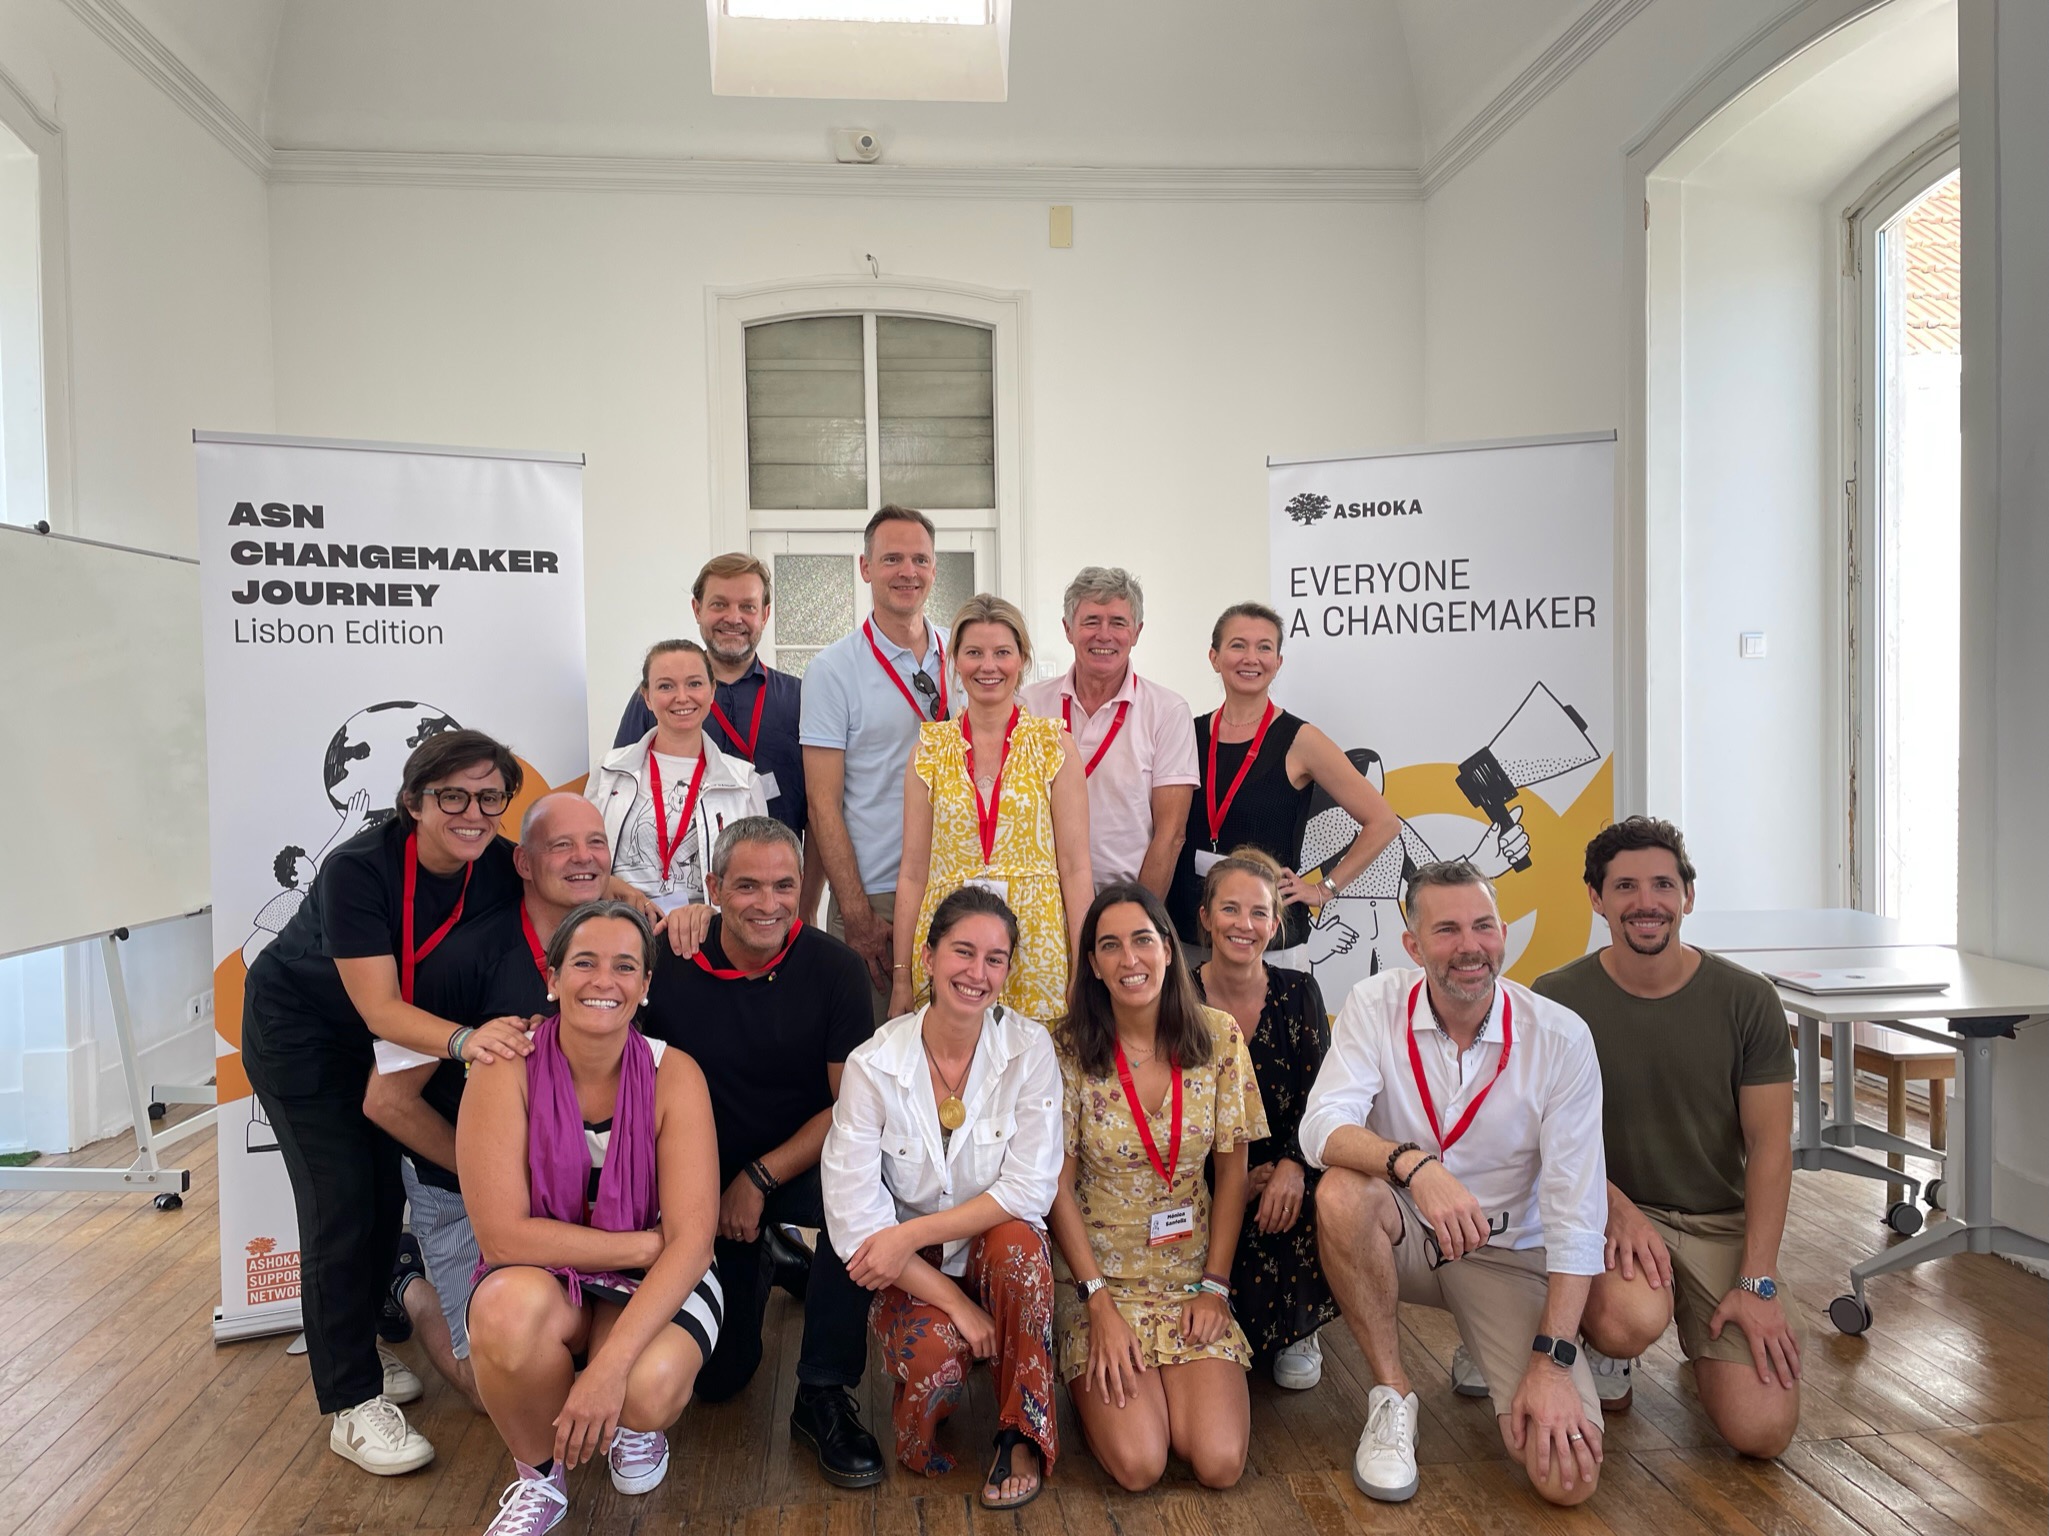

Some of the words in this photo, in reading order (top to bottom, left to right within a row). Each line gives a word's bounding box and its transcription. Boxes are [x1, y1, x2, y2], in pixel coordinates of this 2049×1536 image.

[228, 502, 324, 529] ASN
[1333, 499, 1423, 519] ASHOKA
[230, 540, 559, 574] CHANGEMAKER
[1291, 558, 1470, 598] EVERYONE
[231, 580, 440, 607] JOURNEY
[1289, 608, 1310, 638] A
[1322, 596, 1596, 637] CHANGEMAKER
[234, 618, 334, 644] Lisbon
[346, 620, 443, 645] Edition
[249, 1254, 300, 1272] ASHOKA
[249, 1269, 301, 1287] SUPPOR
[250, 1285, 301, 1304] NETWOR
